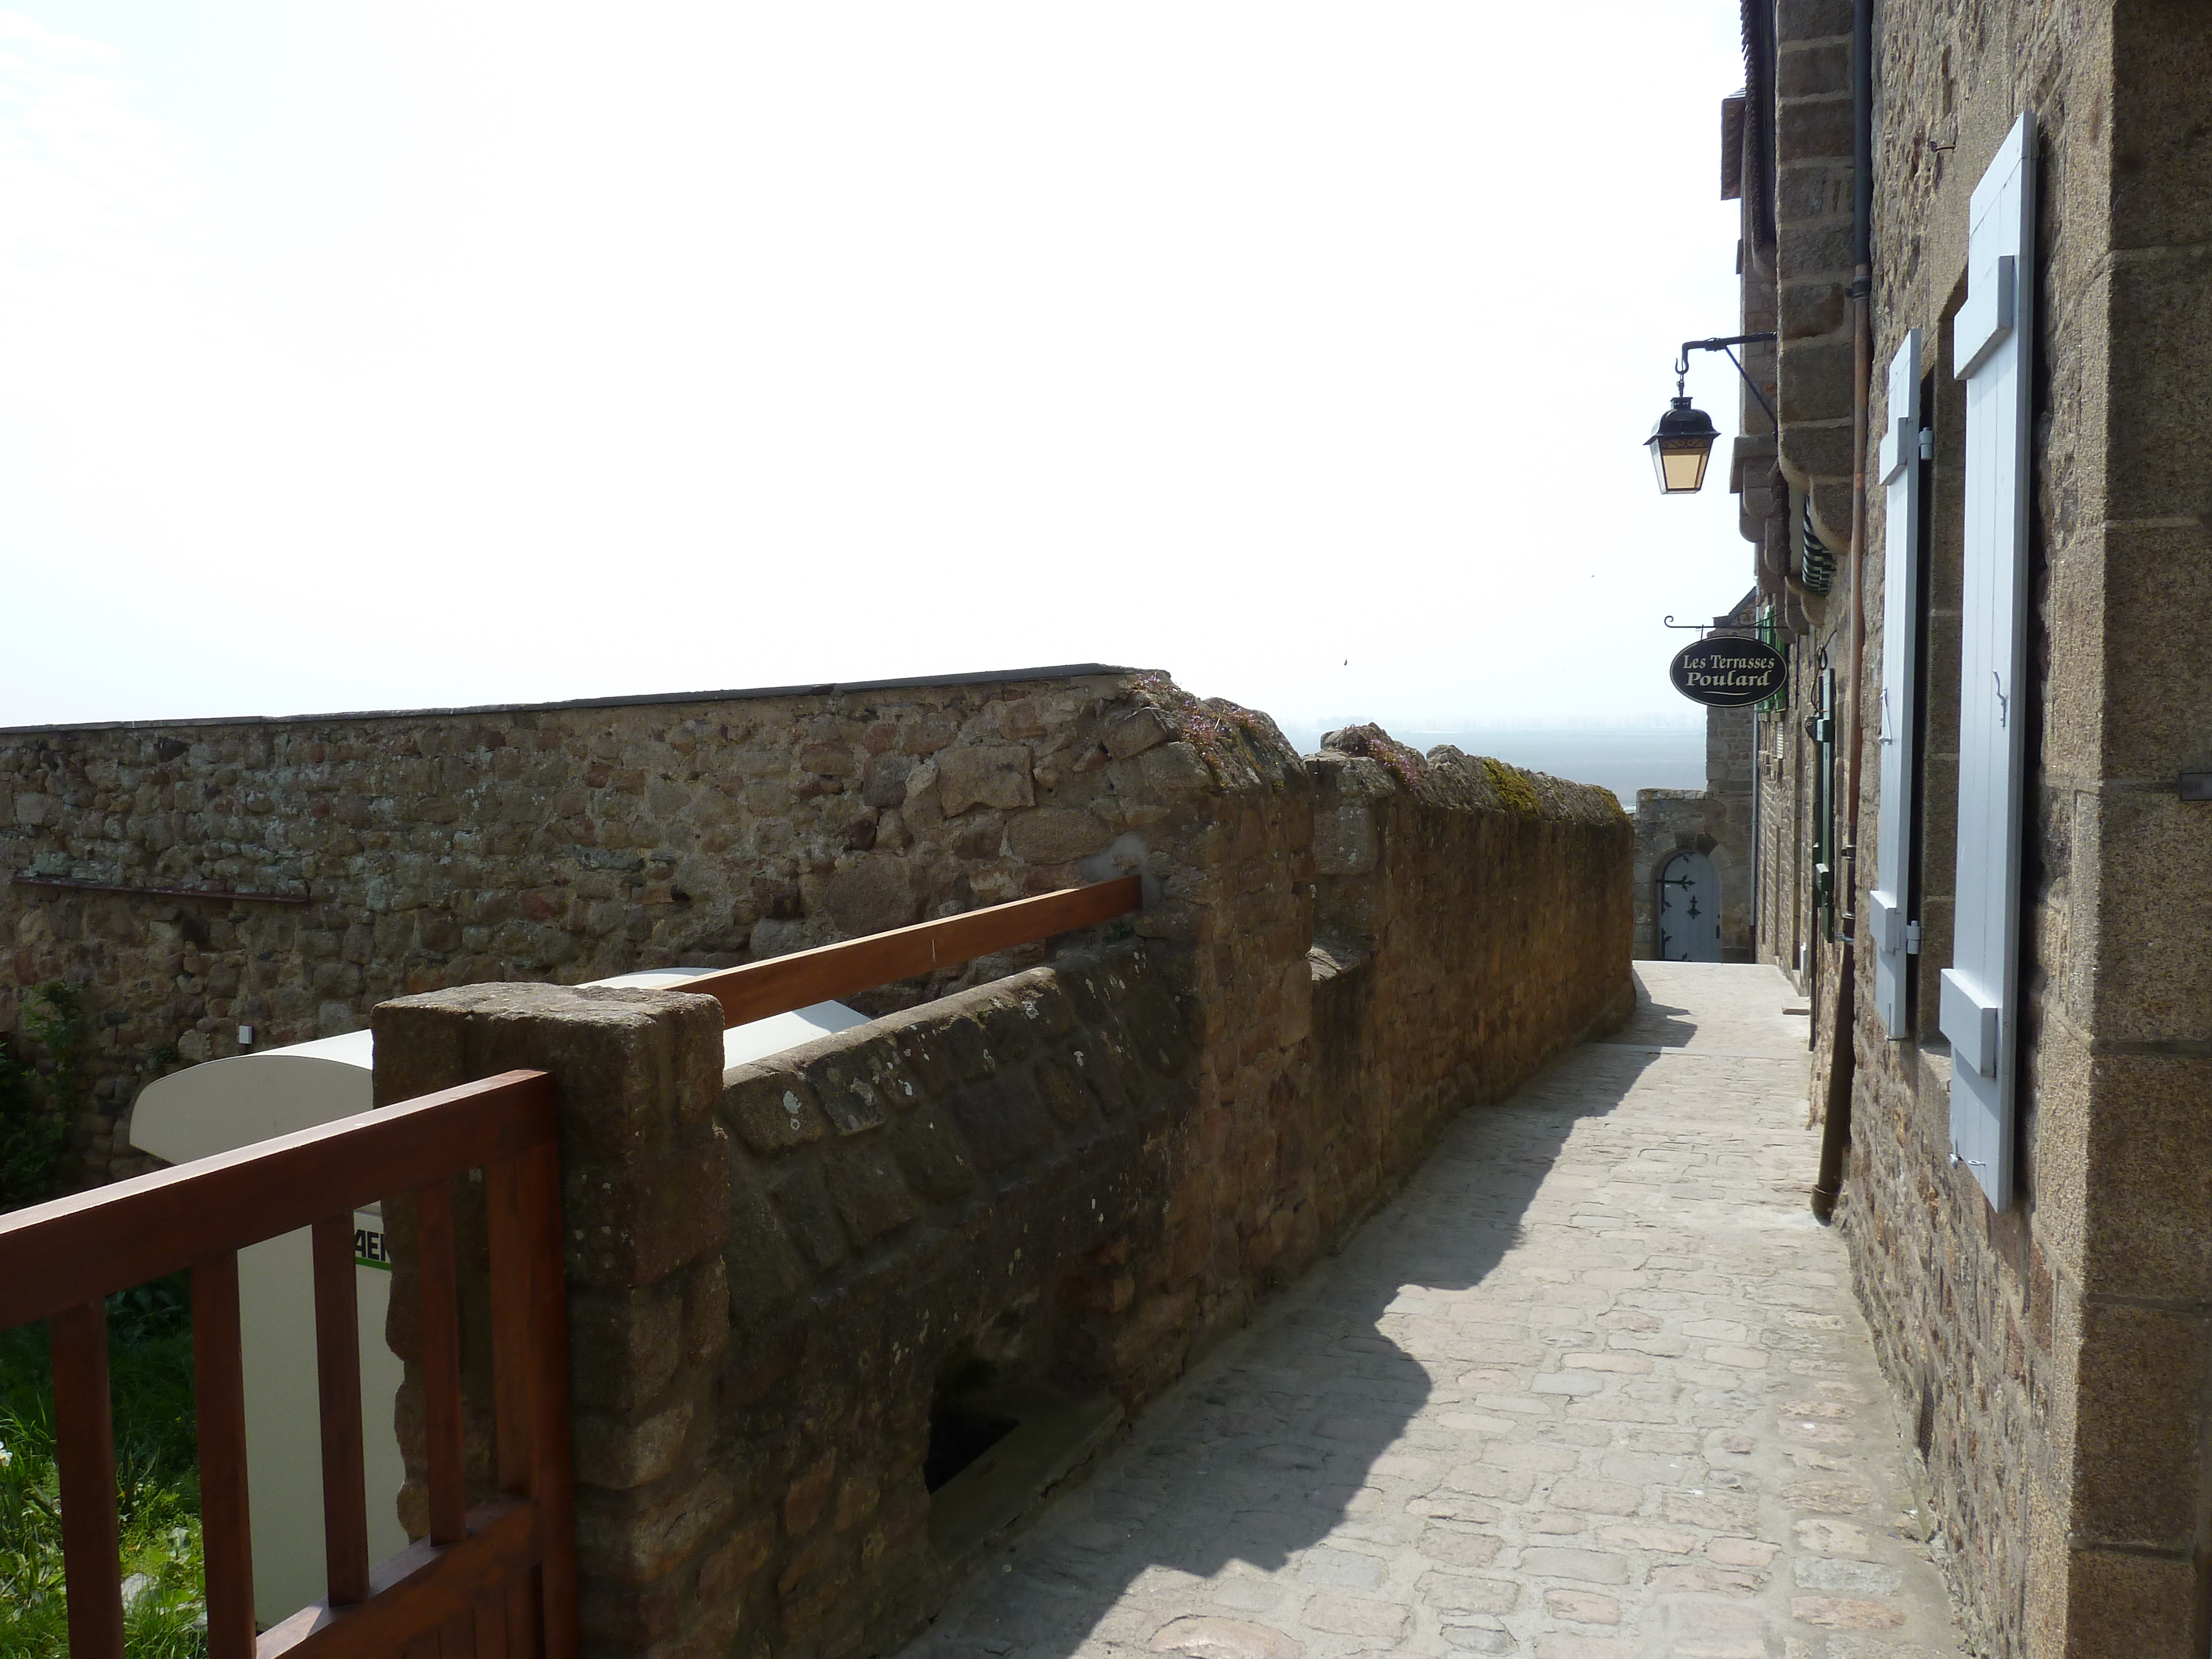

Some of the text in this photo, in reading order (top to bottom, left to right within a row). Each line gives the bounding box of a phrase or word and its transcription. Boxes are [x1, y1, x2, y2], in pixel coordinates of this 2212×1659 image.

[1683, 655, 1775, 669] Les Terrasses
[1686, 670, 1772, 686] Poulard
